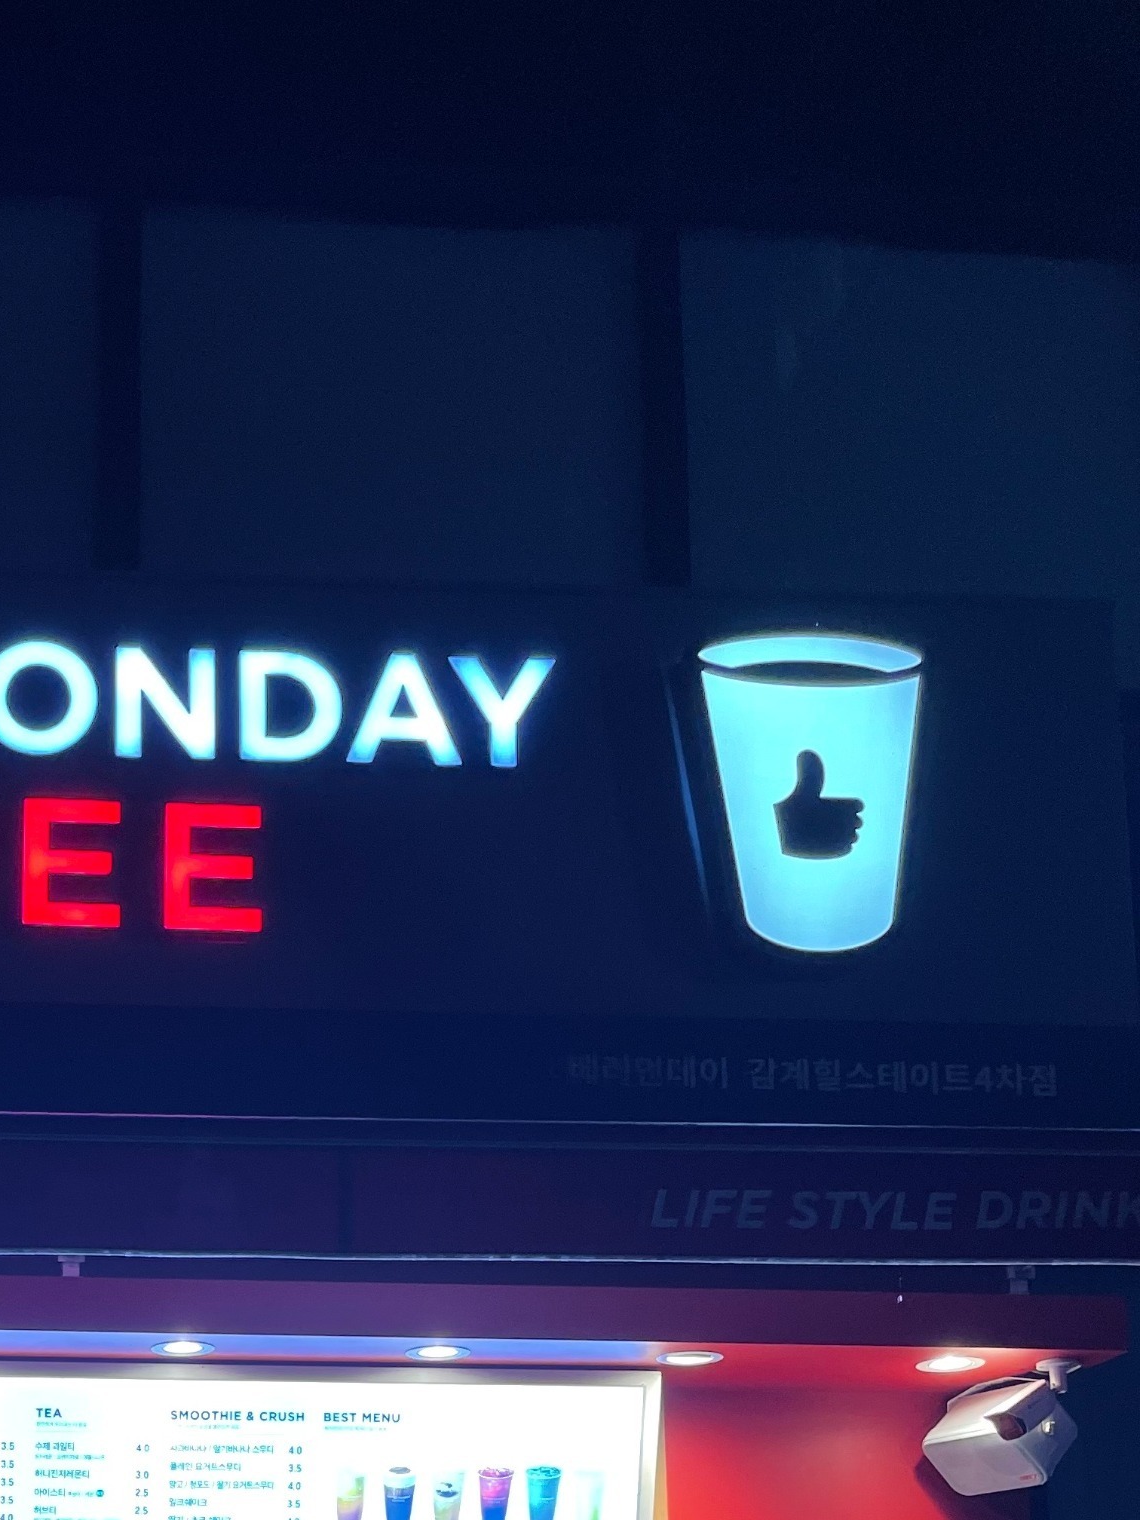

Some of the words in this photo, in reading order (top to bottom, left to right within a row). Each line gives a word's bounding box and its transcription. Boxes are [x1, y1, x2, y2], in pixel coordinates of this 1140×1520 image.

[651, 1188, 773, 1230] LIFE
[787, 1189, 958, 1232] STYLE
[36, 1408, 62, 1418] TEA
[171, 1411, 241, 1421] SMOOTHIE
[246, 1412, 254, 1421] &
[260, 1412, 304, 1421] CRUSH
[324, 1413, 356, 1422] BEST
[363, 1413, 400, 1422] MENU
[1, 1442, 15, 1450] 3.5
[289, 1446, 302, 1455] 4.0
[1, 1460, 14, 1468] 3.5
[289, 1464, 302, 1472] 3.5
[1, 1478, 14, 1486] 3.5
[288, 1482, 301, 1490] 4.0
[1, 1496, 13, 1504] 3.5
